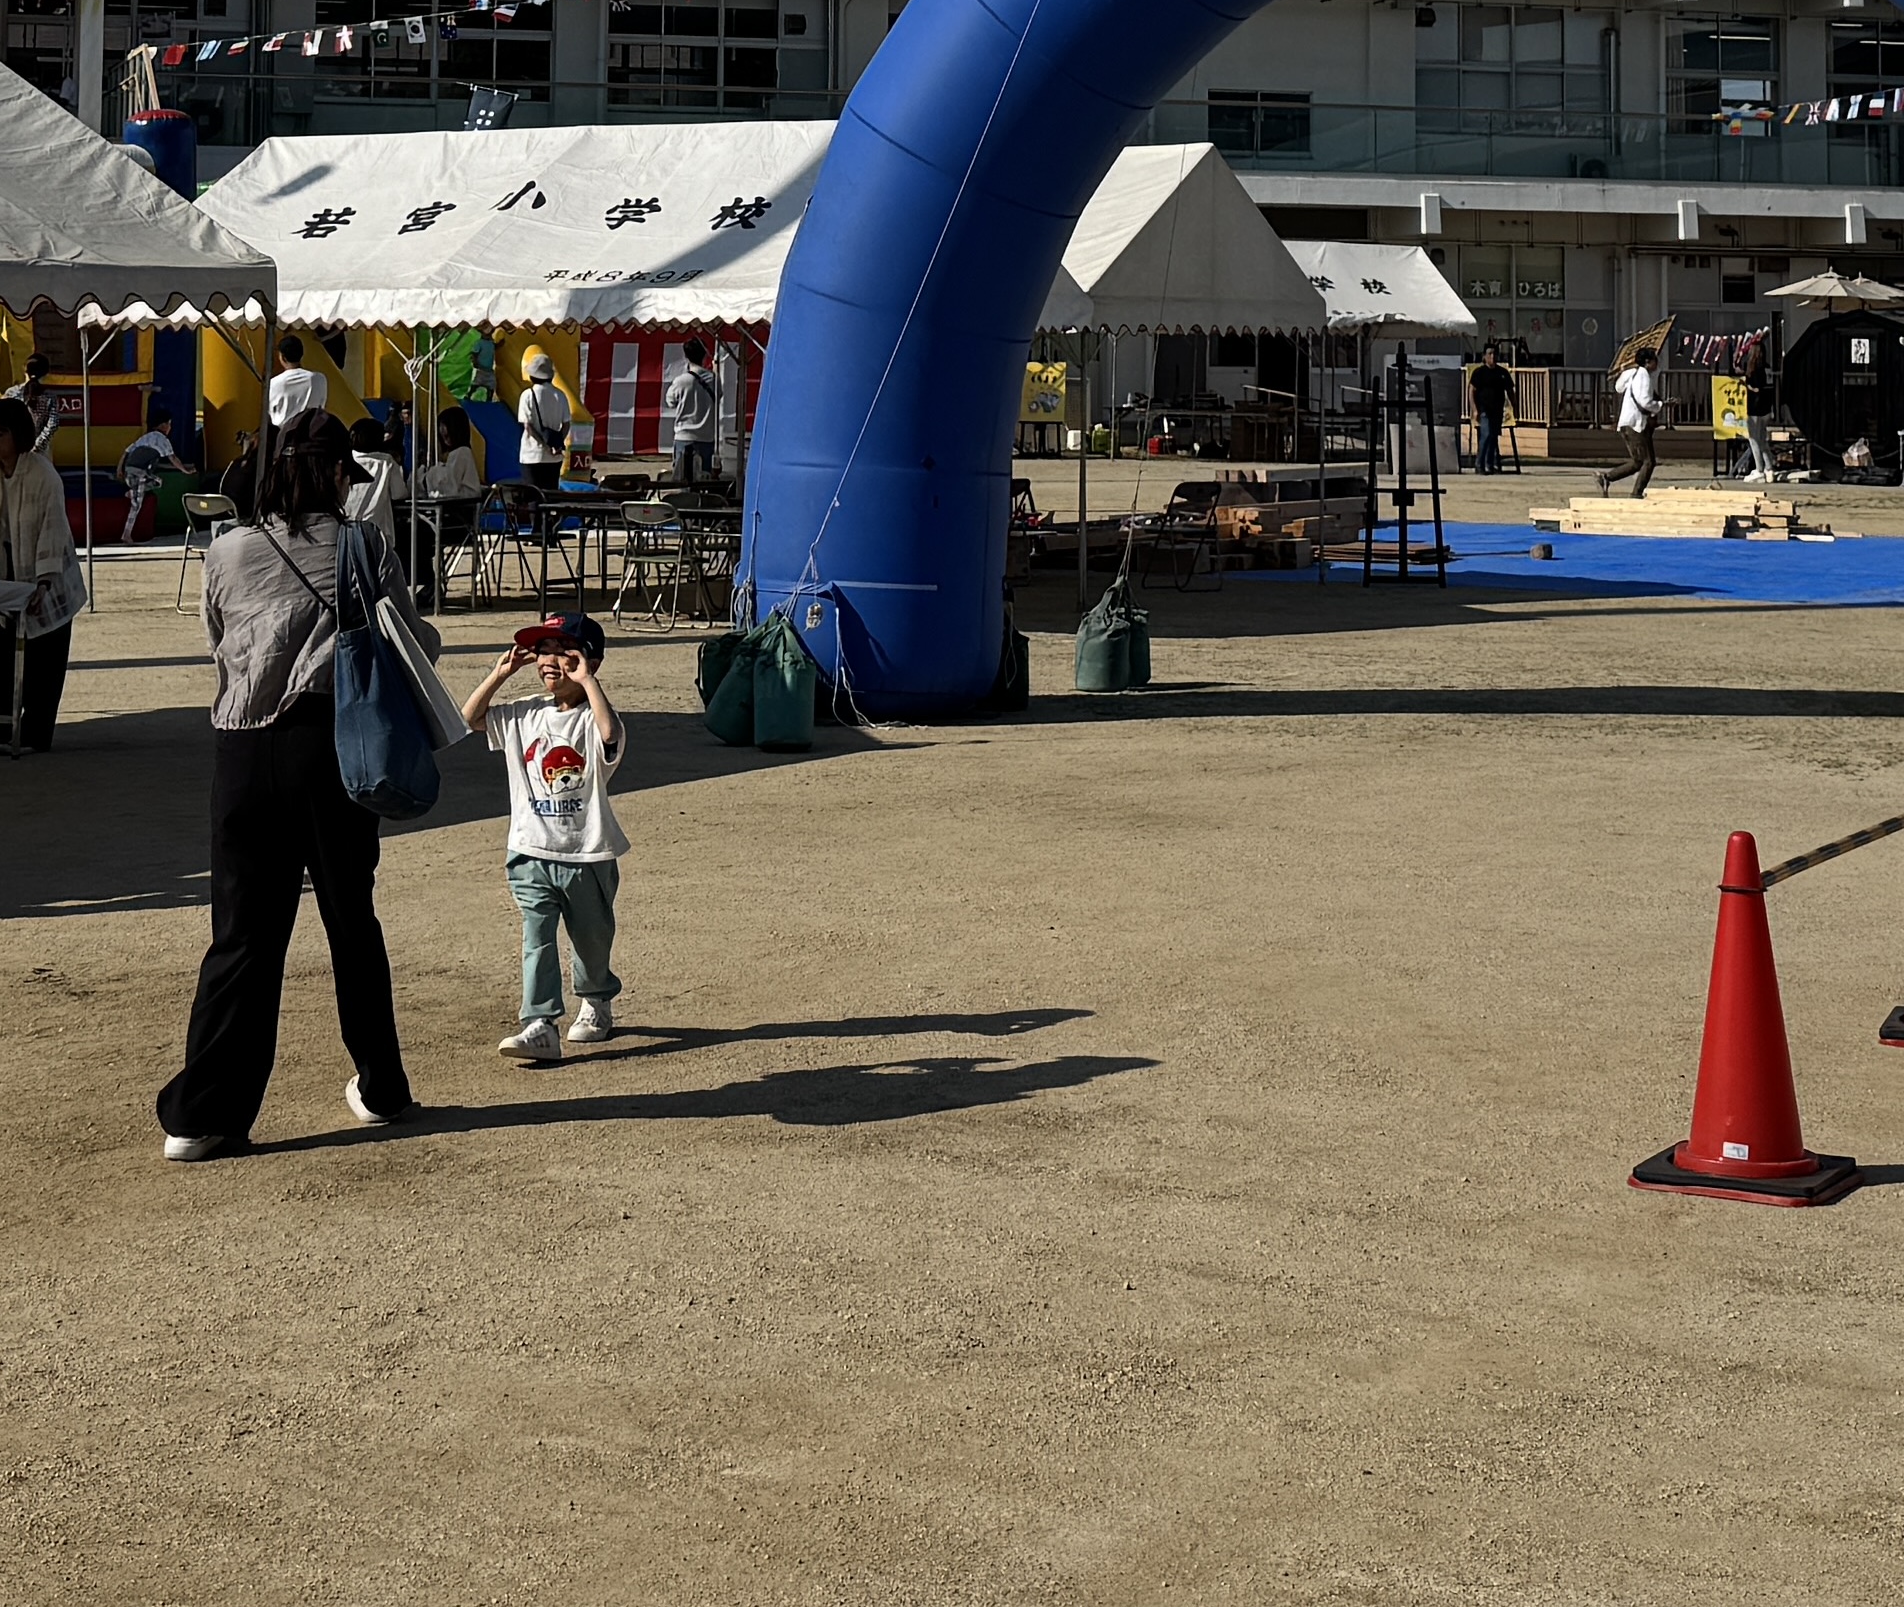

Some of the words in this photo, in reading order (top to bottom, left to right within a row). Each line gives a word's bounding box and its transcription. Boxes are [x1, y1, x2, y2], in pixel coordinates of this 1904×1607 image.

[291, 179, 772, 240] 若宮小学校
[59, 397, 82, 412] 入口
